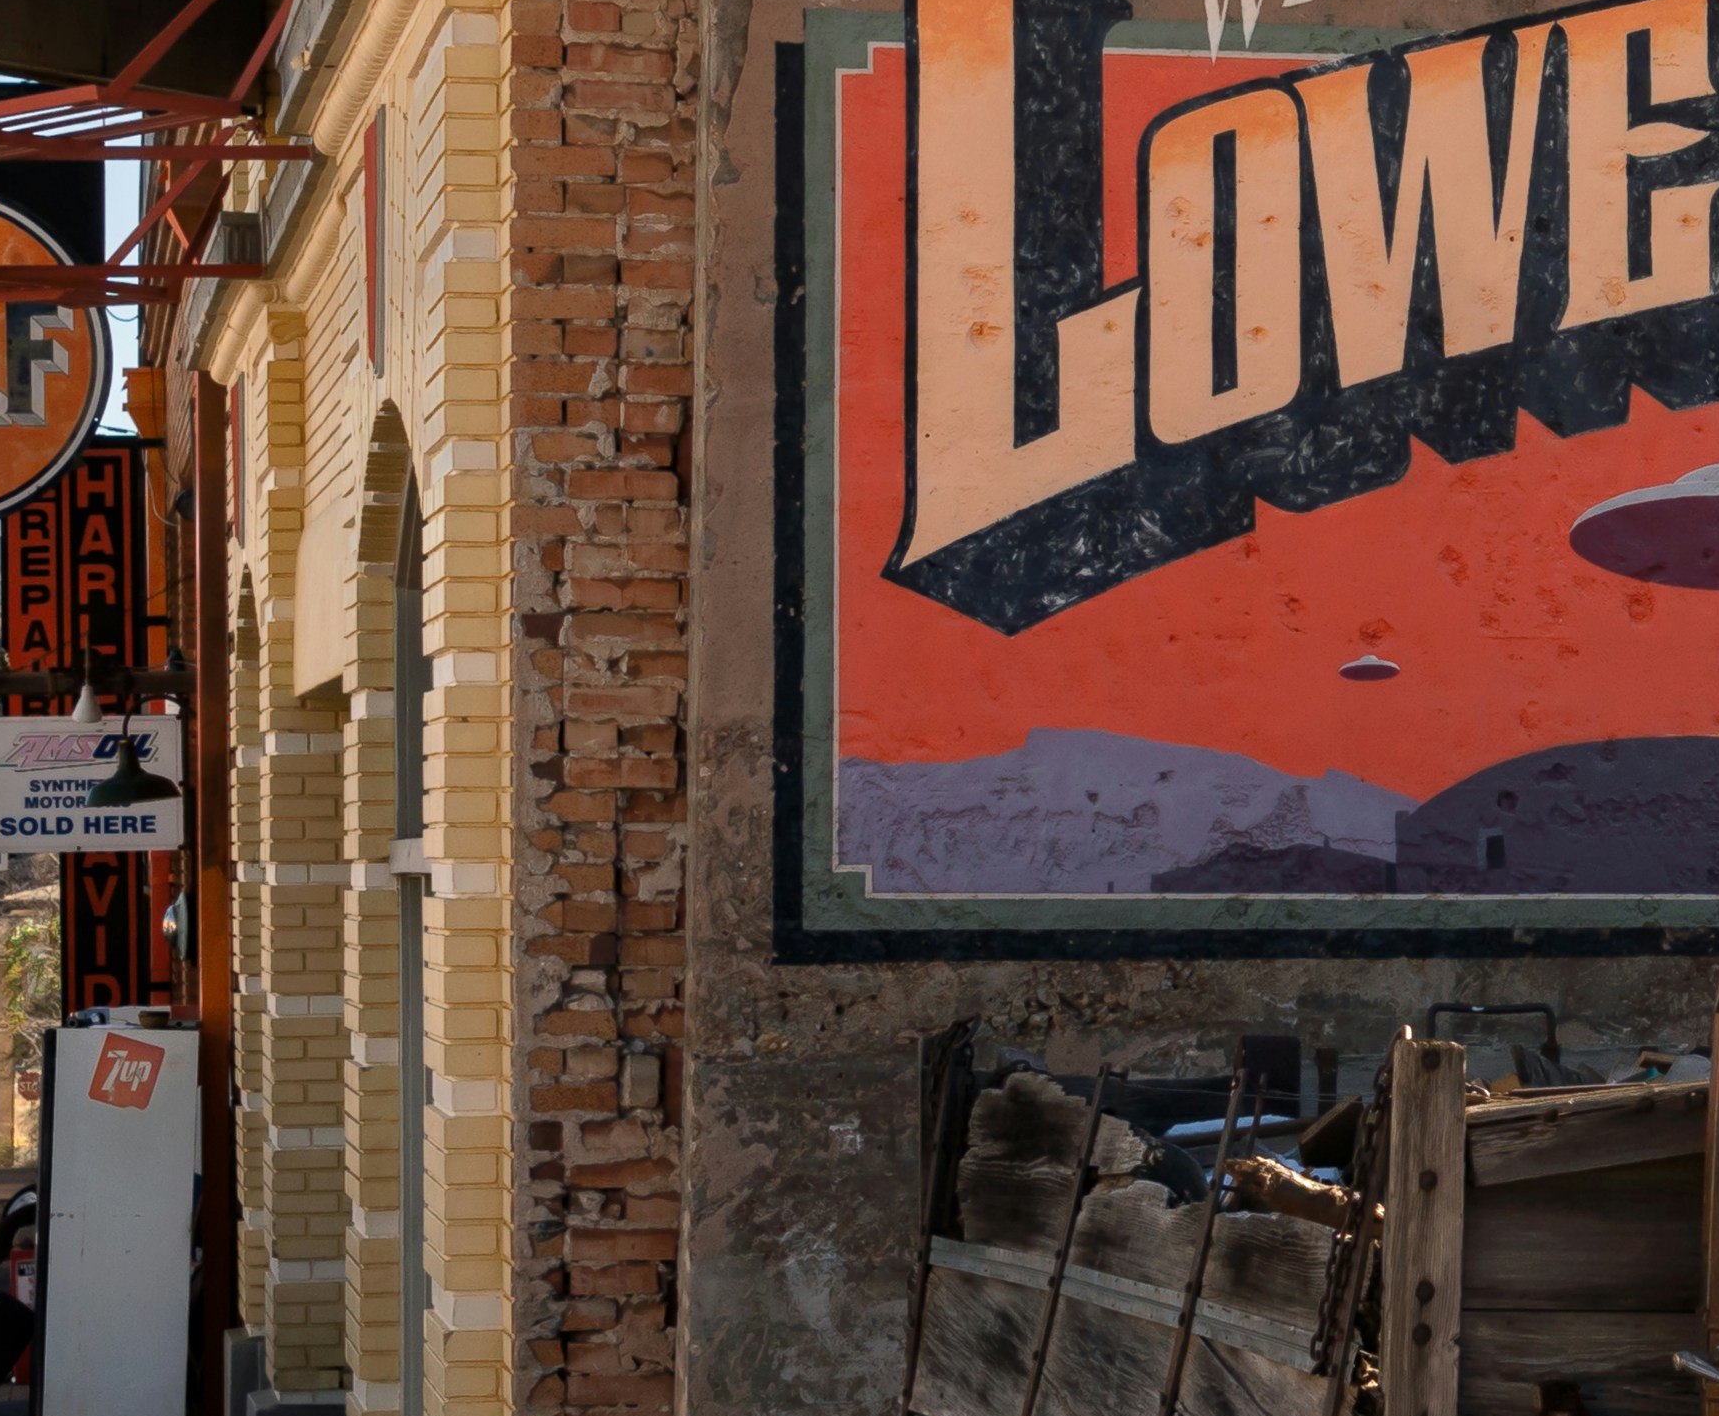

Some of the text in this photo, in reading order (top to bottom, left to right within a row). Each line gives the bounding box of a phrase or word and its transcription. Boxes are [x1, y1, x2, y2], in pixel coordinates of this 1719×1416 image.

[0, 815, 157, 837] SOLD HERE
[19, 1081, 39, 1093] STO
